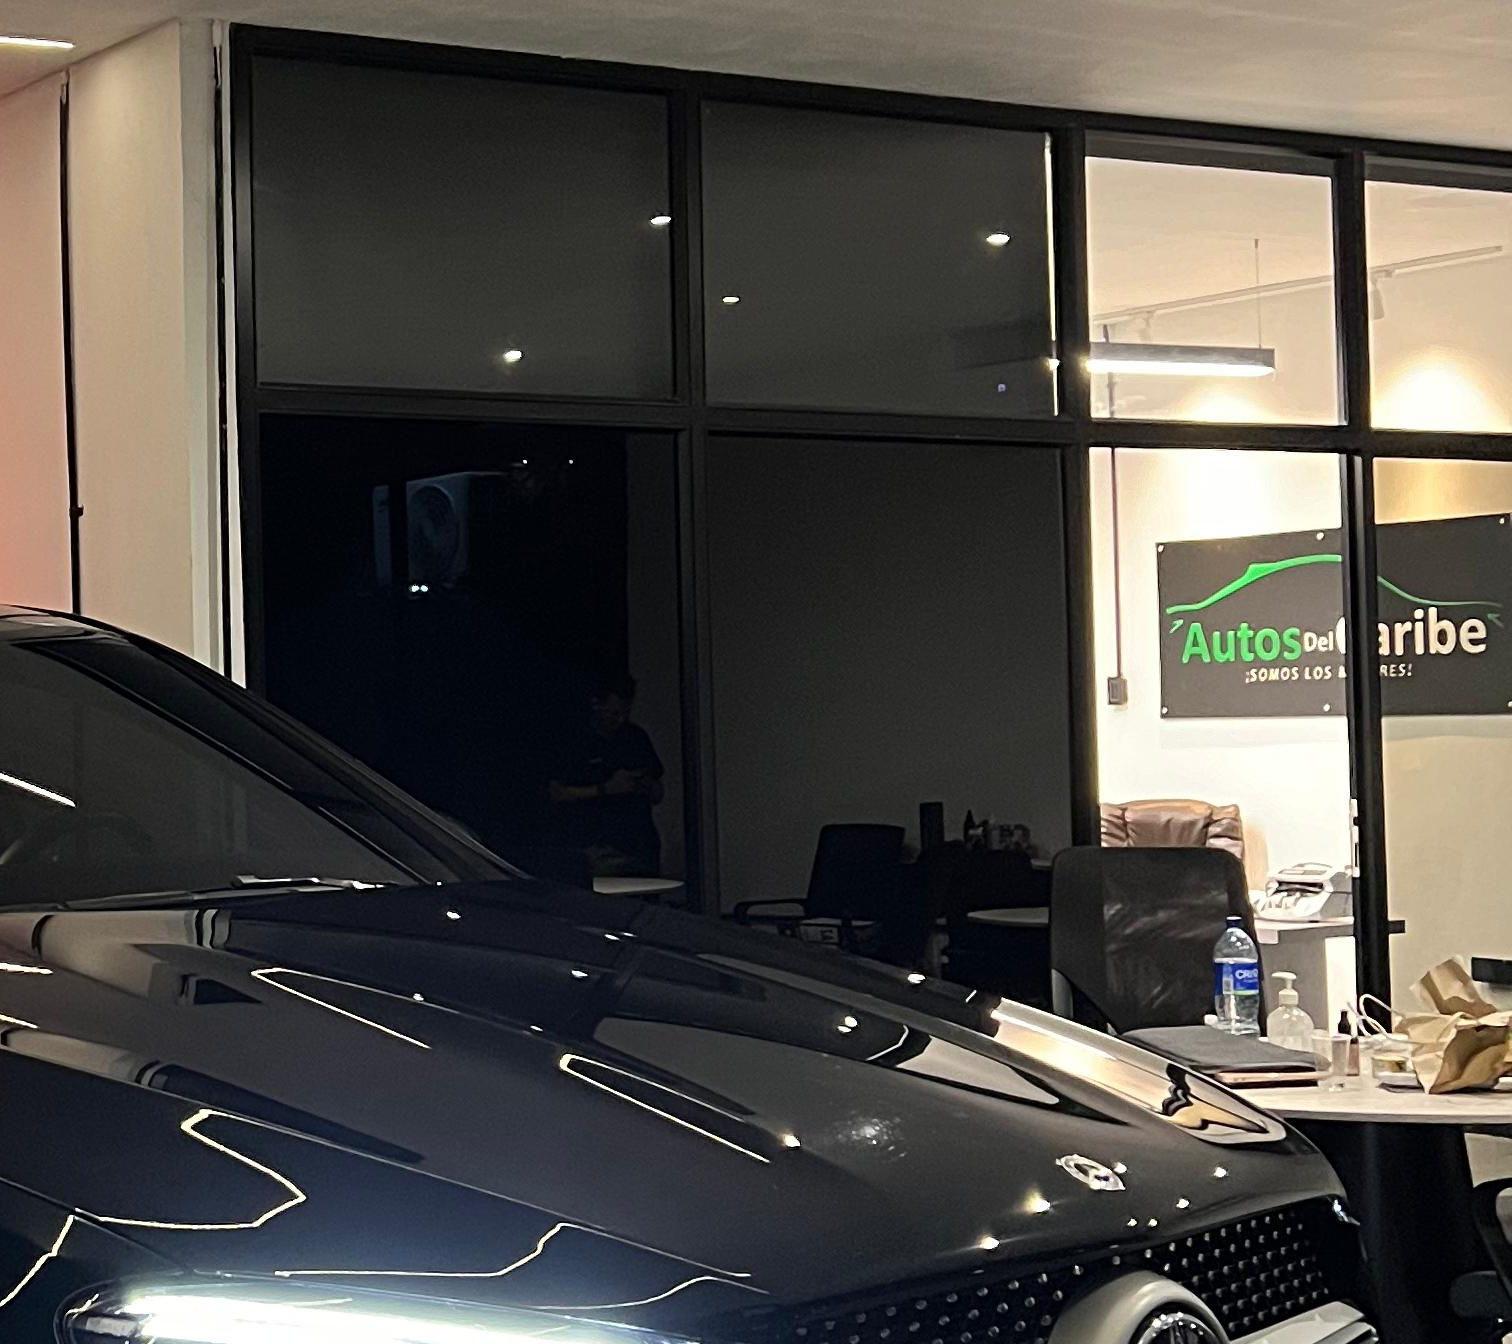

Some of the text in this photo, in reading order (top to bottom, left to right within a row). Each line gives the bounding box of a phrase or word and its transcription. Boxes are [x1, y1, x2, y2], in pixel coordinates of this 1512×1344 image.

[1181, 622, 1303, 664] Autos
[1303, 630, 1334, 653] Del
[1304, 666, 1332, 681] LOS
